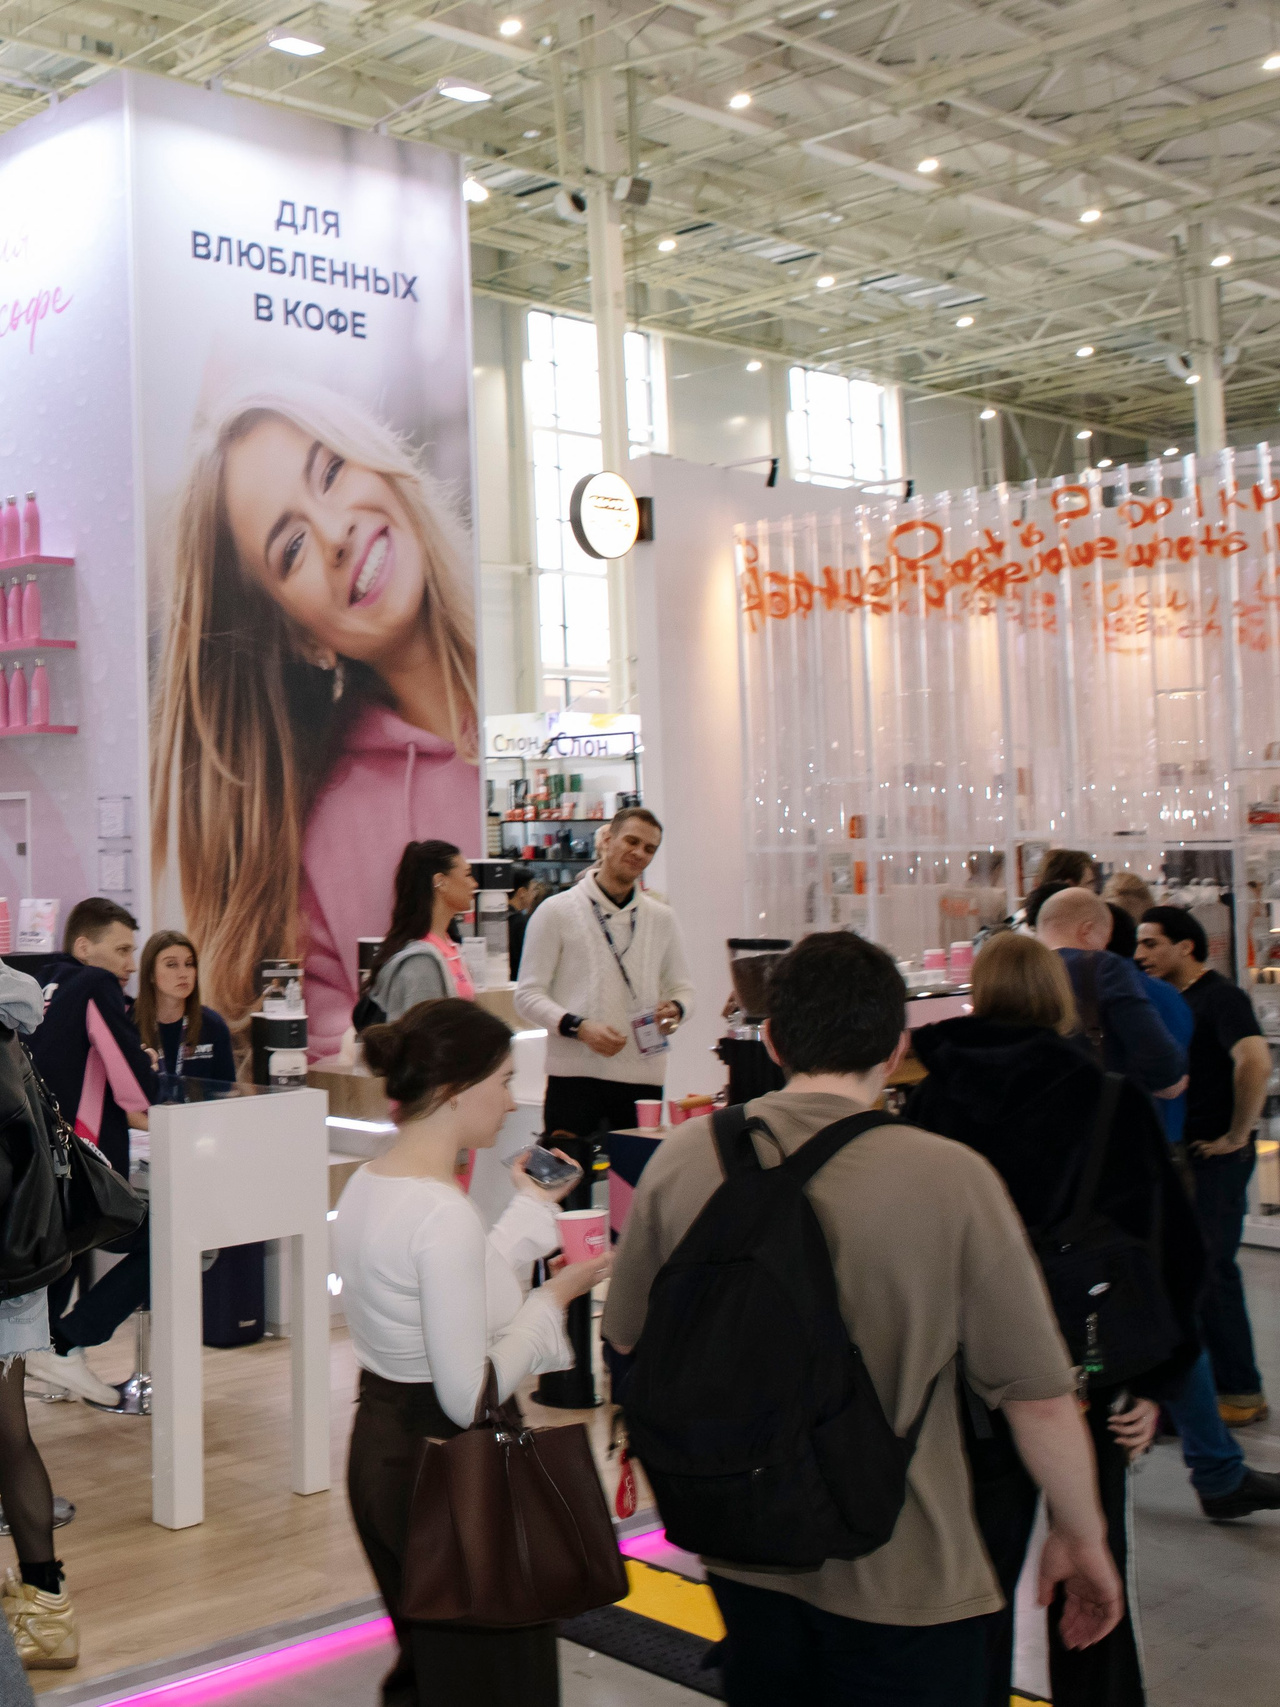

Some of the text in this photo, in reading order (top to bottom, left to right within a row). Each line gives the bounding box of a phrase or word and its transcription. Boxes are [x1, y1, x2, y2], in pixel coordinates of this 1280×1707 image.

[275, 199, 340, 238] ДЛЯ
[191, 230, 419, 303] ВЛЮБЛЕННЫХ
[254, 293, 368, 339] В КОФЕ
[556, 732, 609, 757] Слон
